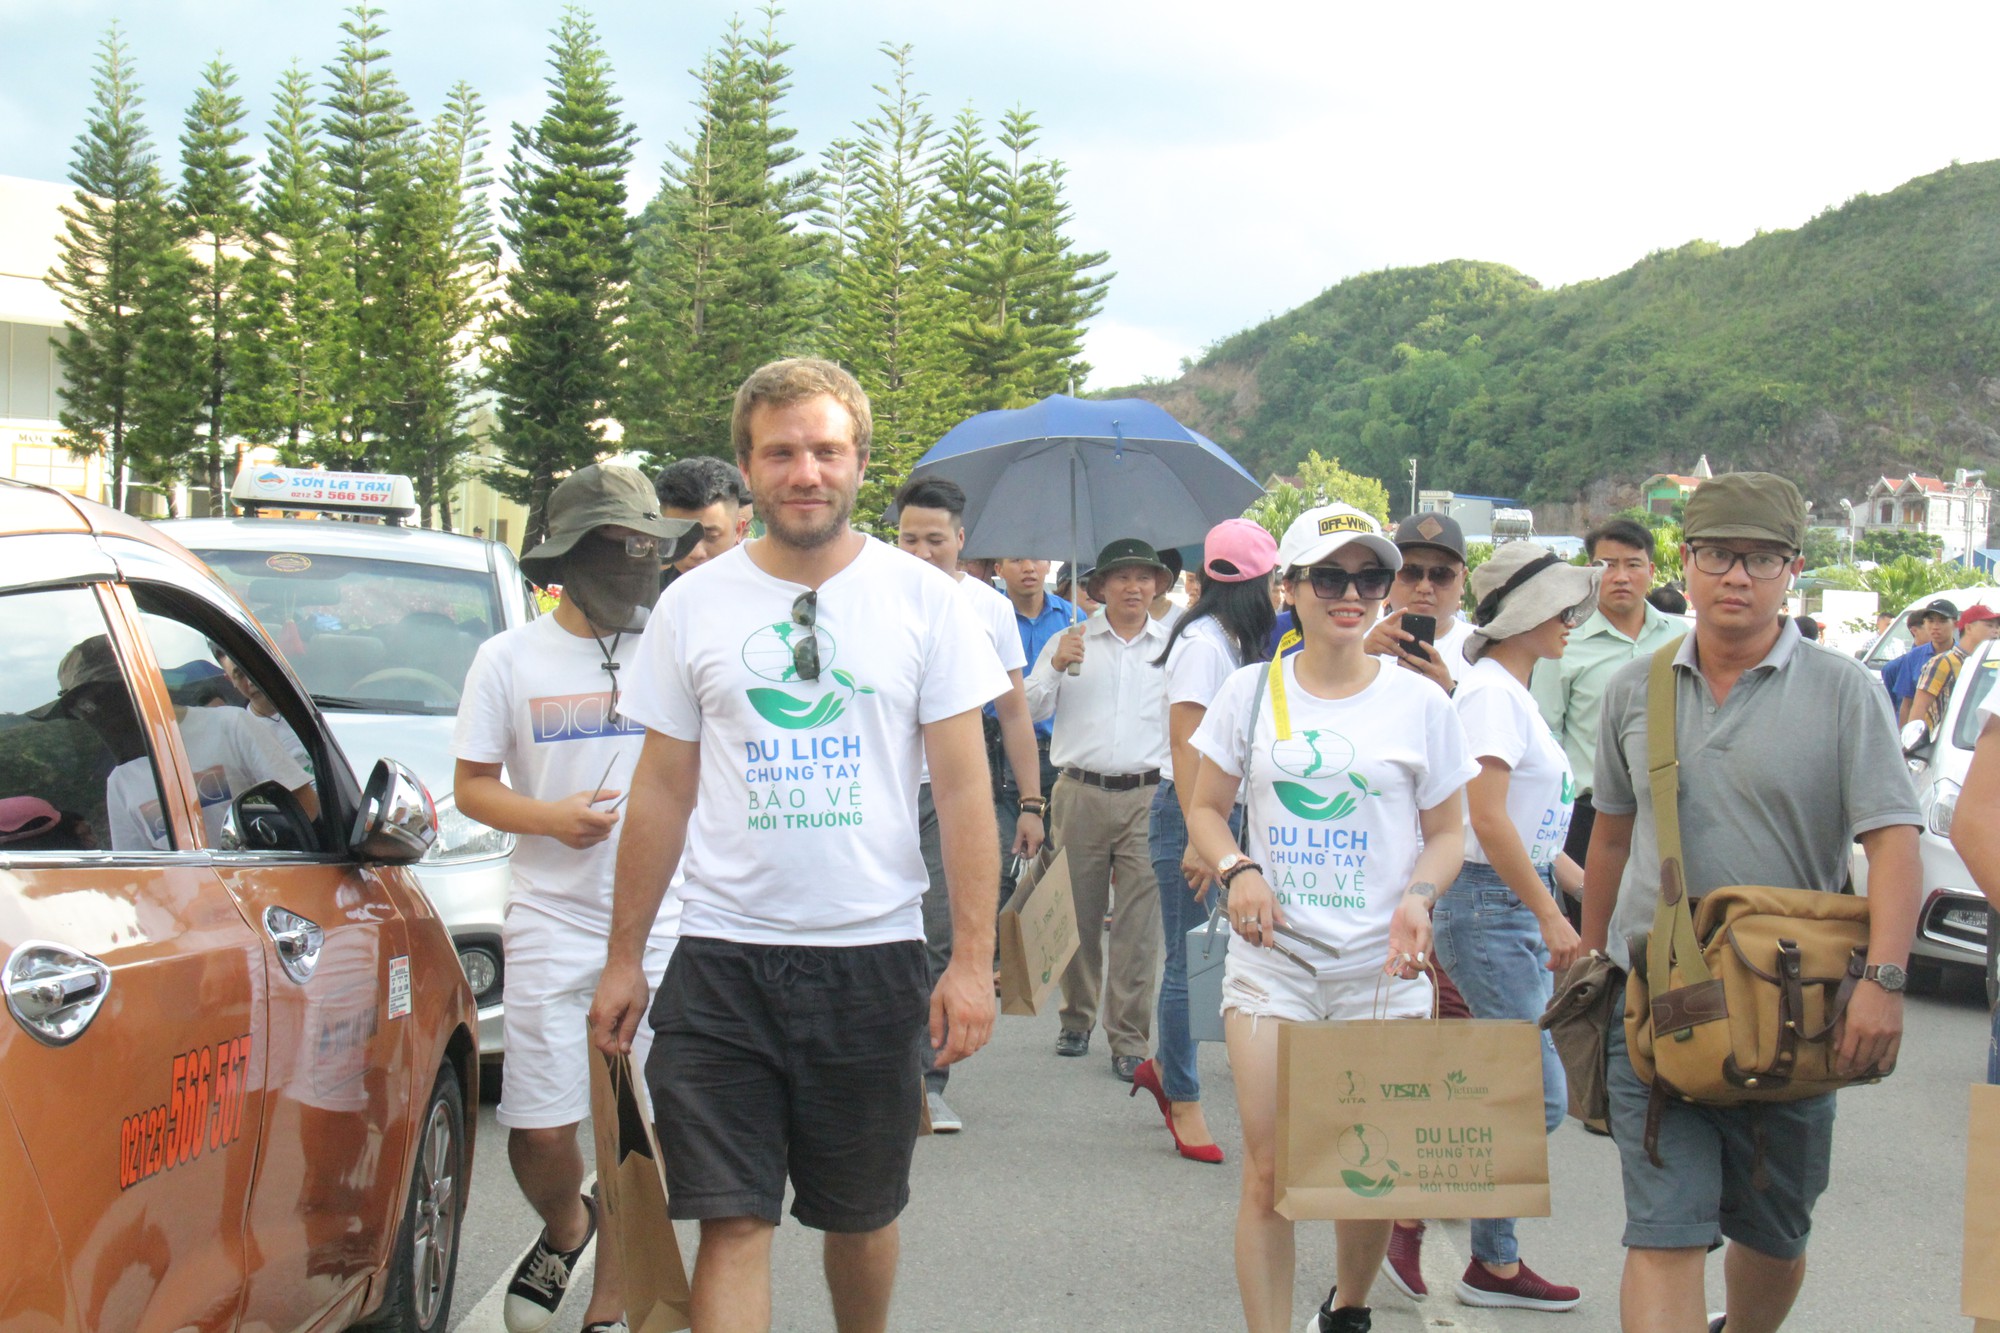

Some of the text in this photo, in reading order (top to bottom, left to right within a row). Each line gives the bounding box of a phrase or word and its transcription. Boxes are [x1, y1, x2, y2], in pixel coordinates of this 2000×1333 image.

[292, 477, 391, 492] SƠN LA TAXI
[313, 490, 323, 499] 3
[328, 491, 356, 501] 566
[360, 493, 389, 502] 567
[745, 735, 861, 765] DU LỊCH
[746, 763, 861, 783] CHUNG TAY
[748, 780, 862, 810] BẢO VỆ
[748, 808, 863, 830] MÔI TRƯỜNG
[1268, 826, 1368, 853] DU LỊCH
[1270, 850, 1366, 868] CHUNG TAY
[1272, 866, 1366, 895] BẢO VỆ
[1276, 890, 1366, 909] ÔI TRƯỜNG
[1380, 1083, 1431, 1098] VISTA
[120, 1033, 253, 1192] 02123 566 567
[1415, 1126, 1492, 1147] DU LỊCH
[1417, 1147, 1492, 1159] CHUNG TAY
